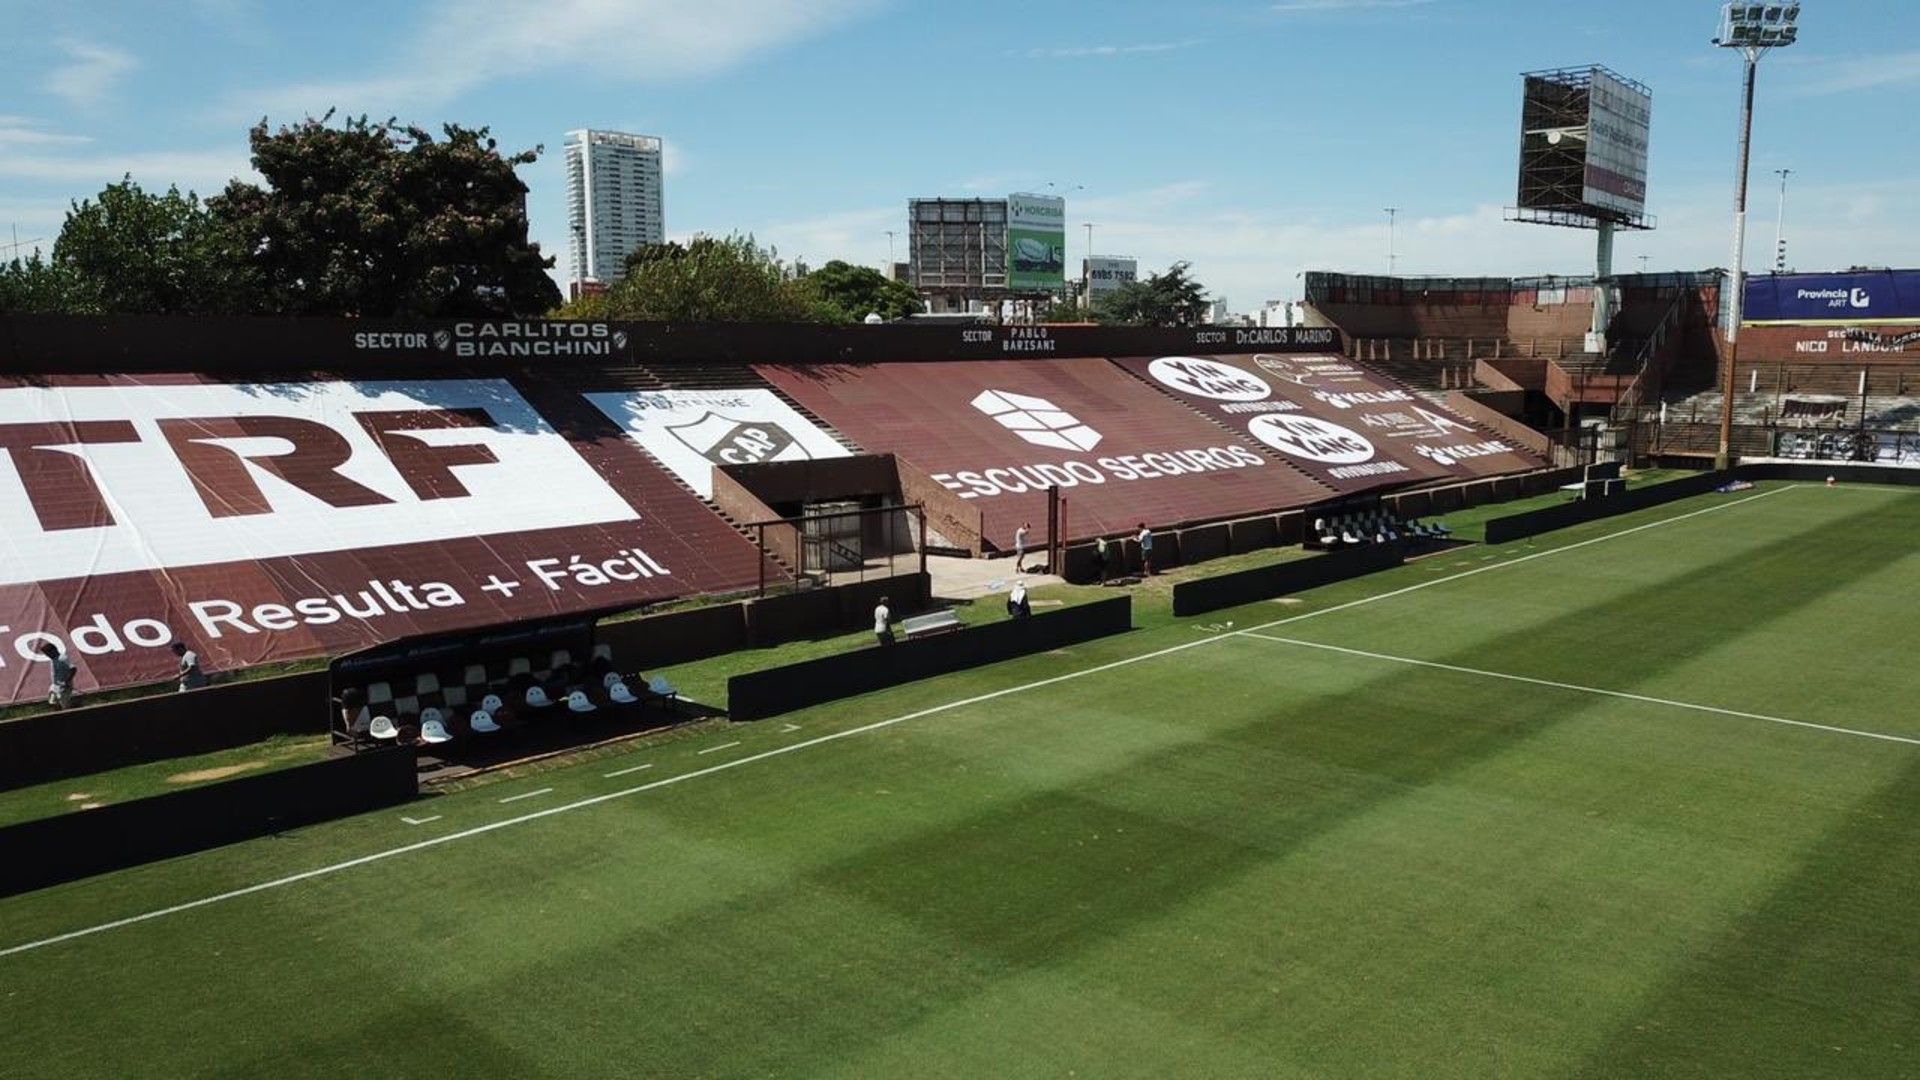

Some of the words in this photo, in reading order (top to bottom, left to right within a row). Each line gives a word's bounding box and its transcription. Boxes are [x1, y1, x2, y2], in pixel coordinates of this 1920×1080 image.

[1797, 288, 1848, 299] Provincia
[455, 323, 608, 337] CARLITOS
[963, 331, 992, 341] SECTOR
[1011, 328, 1047, 338] PABLO
[1196, 332, 1226, 343] SECTOR
[1295, 329, 1332, 343] MARINO
[354, 333, 427, 348] SECTOR
[455, 341, 610, 356] BIANCHINI
[1003, 340, 1055, 350] BARISANI
[1795, 340, 1827, 352] NICO
[1162, 361, 1229, 378] YIN
[1176, 376, 1265, 394] YANG
[1341, 389, 1416, 405] KELME
[1262, 418, 1328, 437] YIN
[719, 427, 777, 465] CAP
[1279, 436, 1368, 456] YANG
[1442, 440, 1515, 458] KELME
[0, 407, 500, 532] TRF
[931, 461, 1105, 498] ESCUDO
[1097, 444, 1266, 480] SEGUROS
[188, 579, 466, 638] Resulta
[481, 574, 521, 598] +
[526, 548, 671, 590] Fácil
